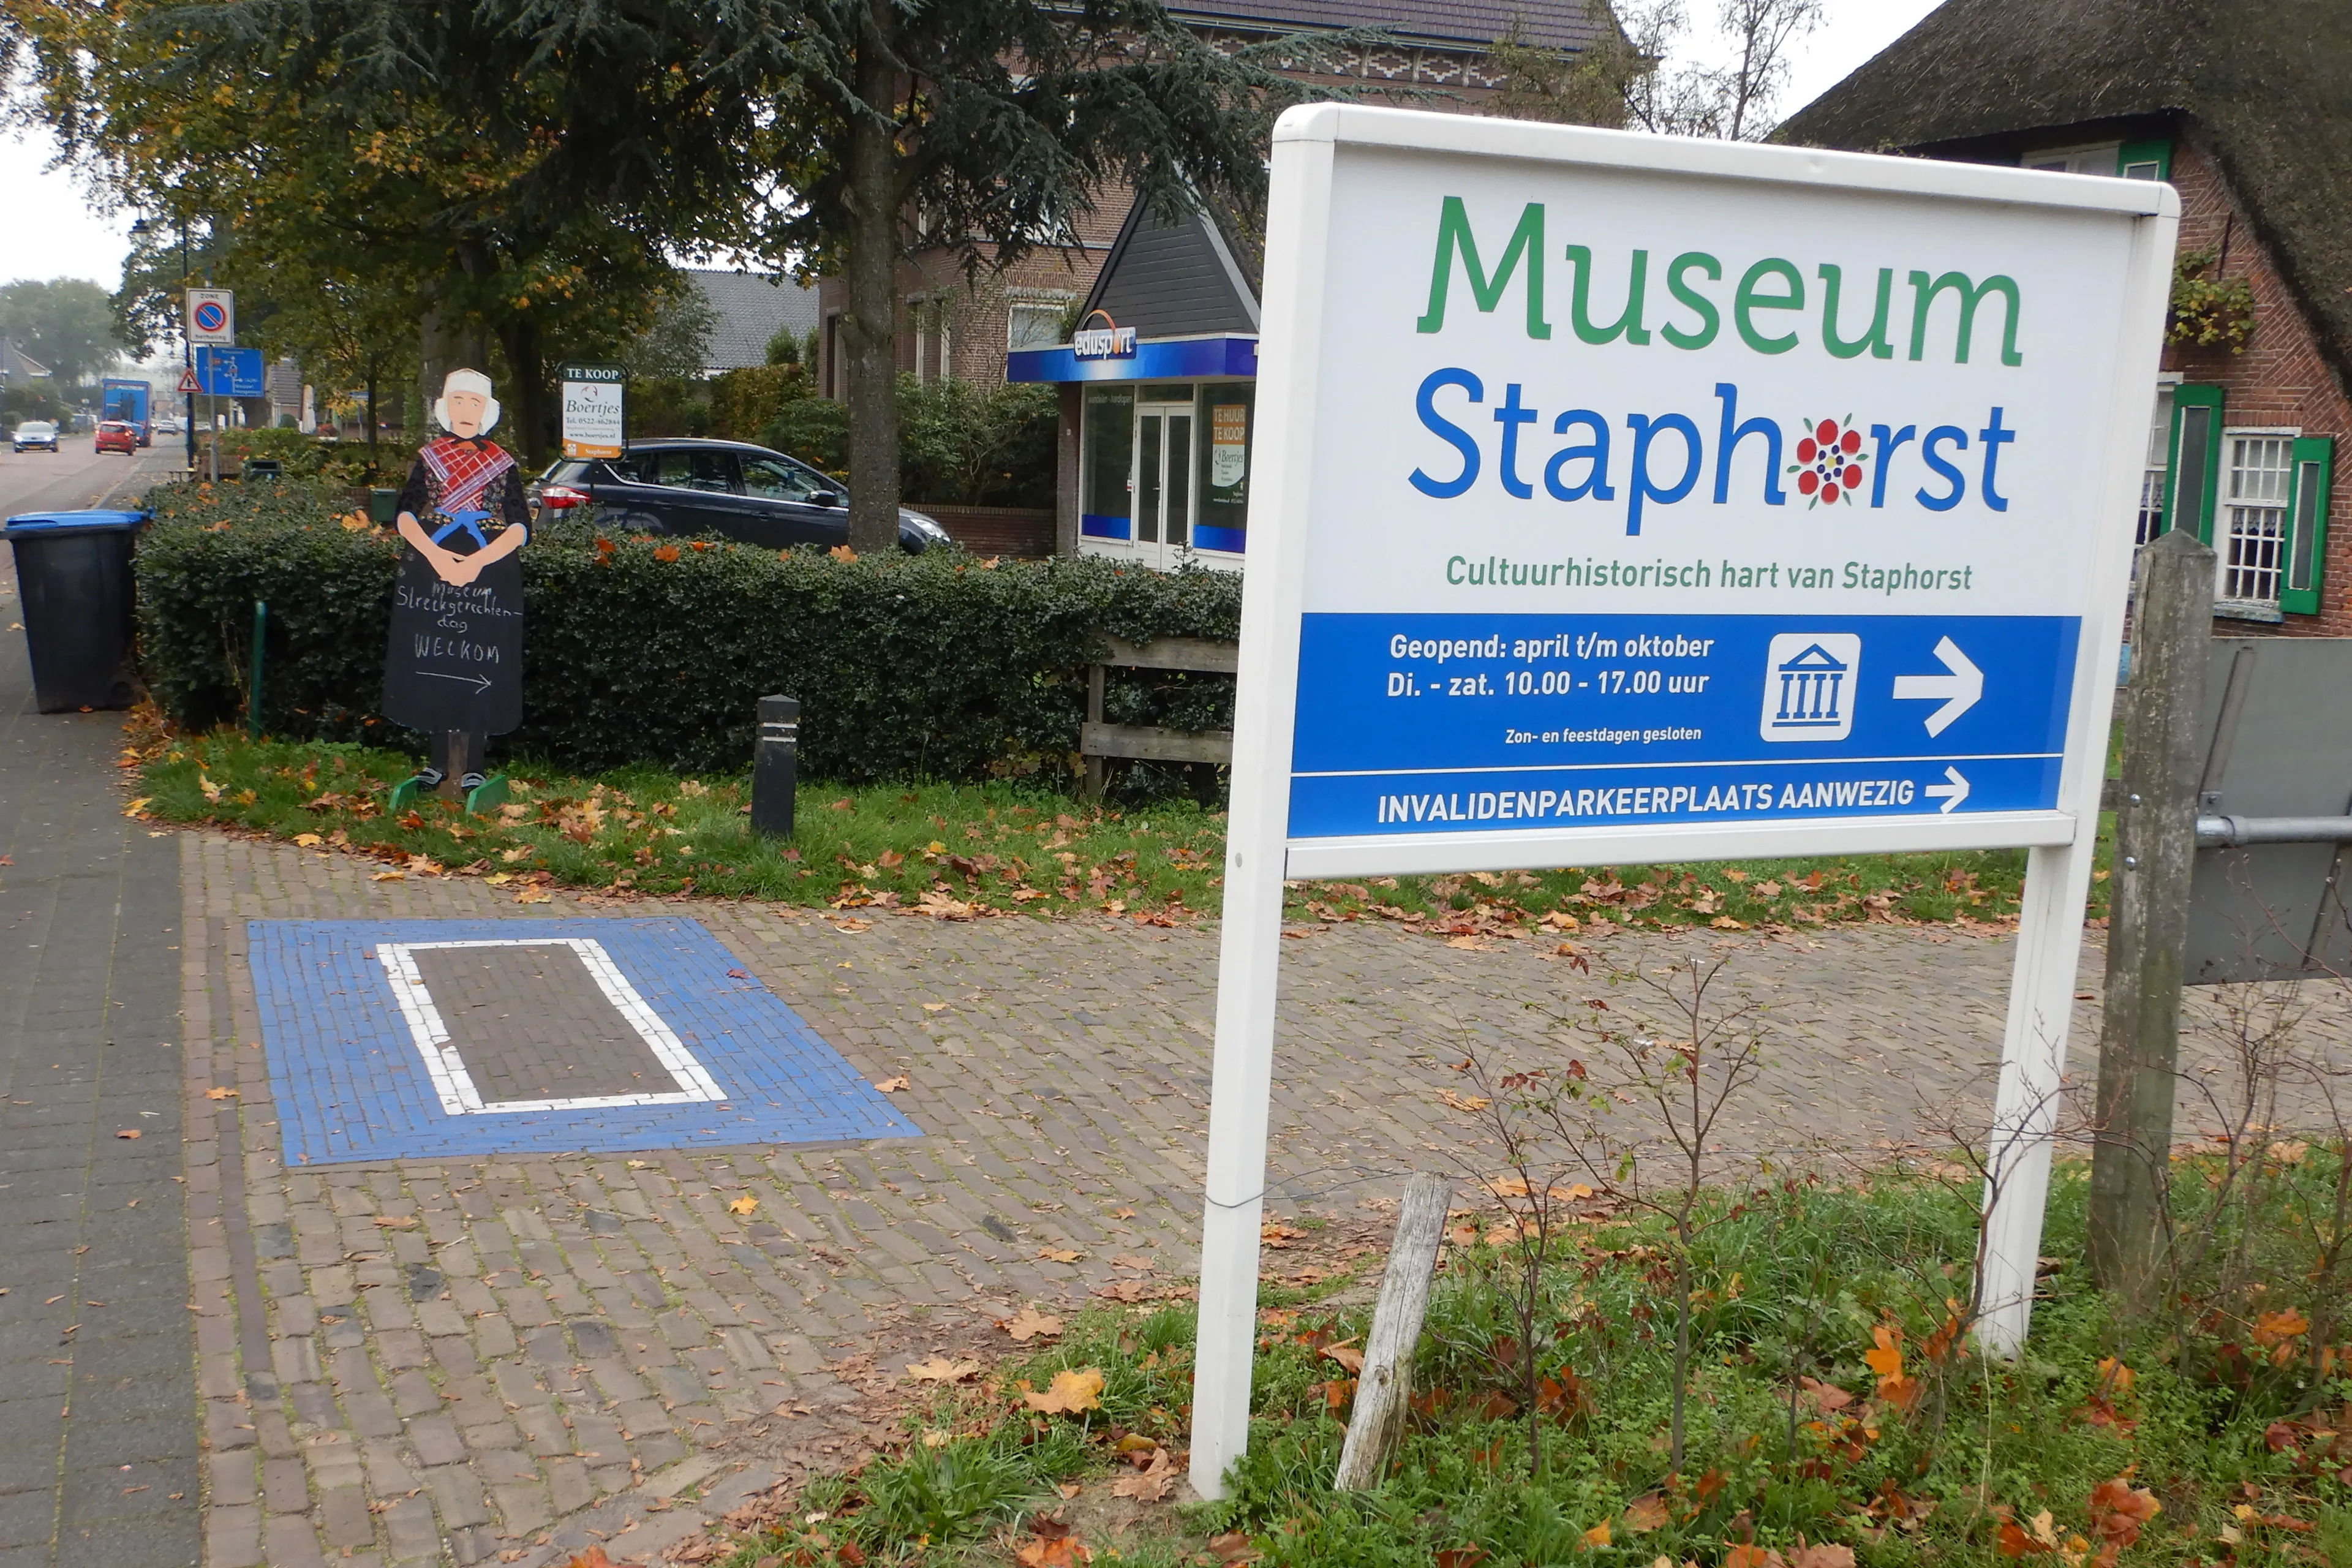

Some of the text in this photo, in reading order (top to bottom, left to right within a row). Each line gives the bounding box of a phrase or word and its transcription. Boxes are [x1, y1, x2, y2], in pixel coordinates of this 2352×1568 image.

[1416, 195, 2024, 366] Museum
[567, 368, 619, 379] TE KOOP
[566, 399, 620, 417] Boertjes
[1214, 409, 1245, 423] TE HUUR
[1214, 427, 1245, 440] TE KOOP
[1221, 450, 1244, 466] Boertjes
[1446, 555, 1973, 597] Cultuurhistorisch hart van Staphorst
[437, 615, 467, 633] dag
[415, 633, 499, 663] WELKOM
[1390, 631, 1716, 665] Geopend: april t/m oktober
[1387, 672, 1421, 697] Di.
[1448, 673, 1494, 696] zat.
[1505, 670, 1571, 696] 10.00
[1597, 669, 1662, 695] 17.00
[1668, 675, 1711, 694] uur
[1505, 726, 1702, 745] Zon- en feestdagen gesloten
[1378, 780, 1915, 824] INVALIDENPARKEERPLAATS AANWEZIG
